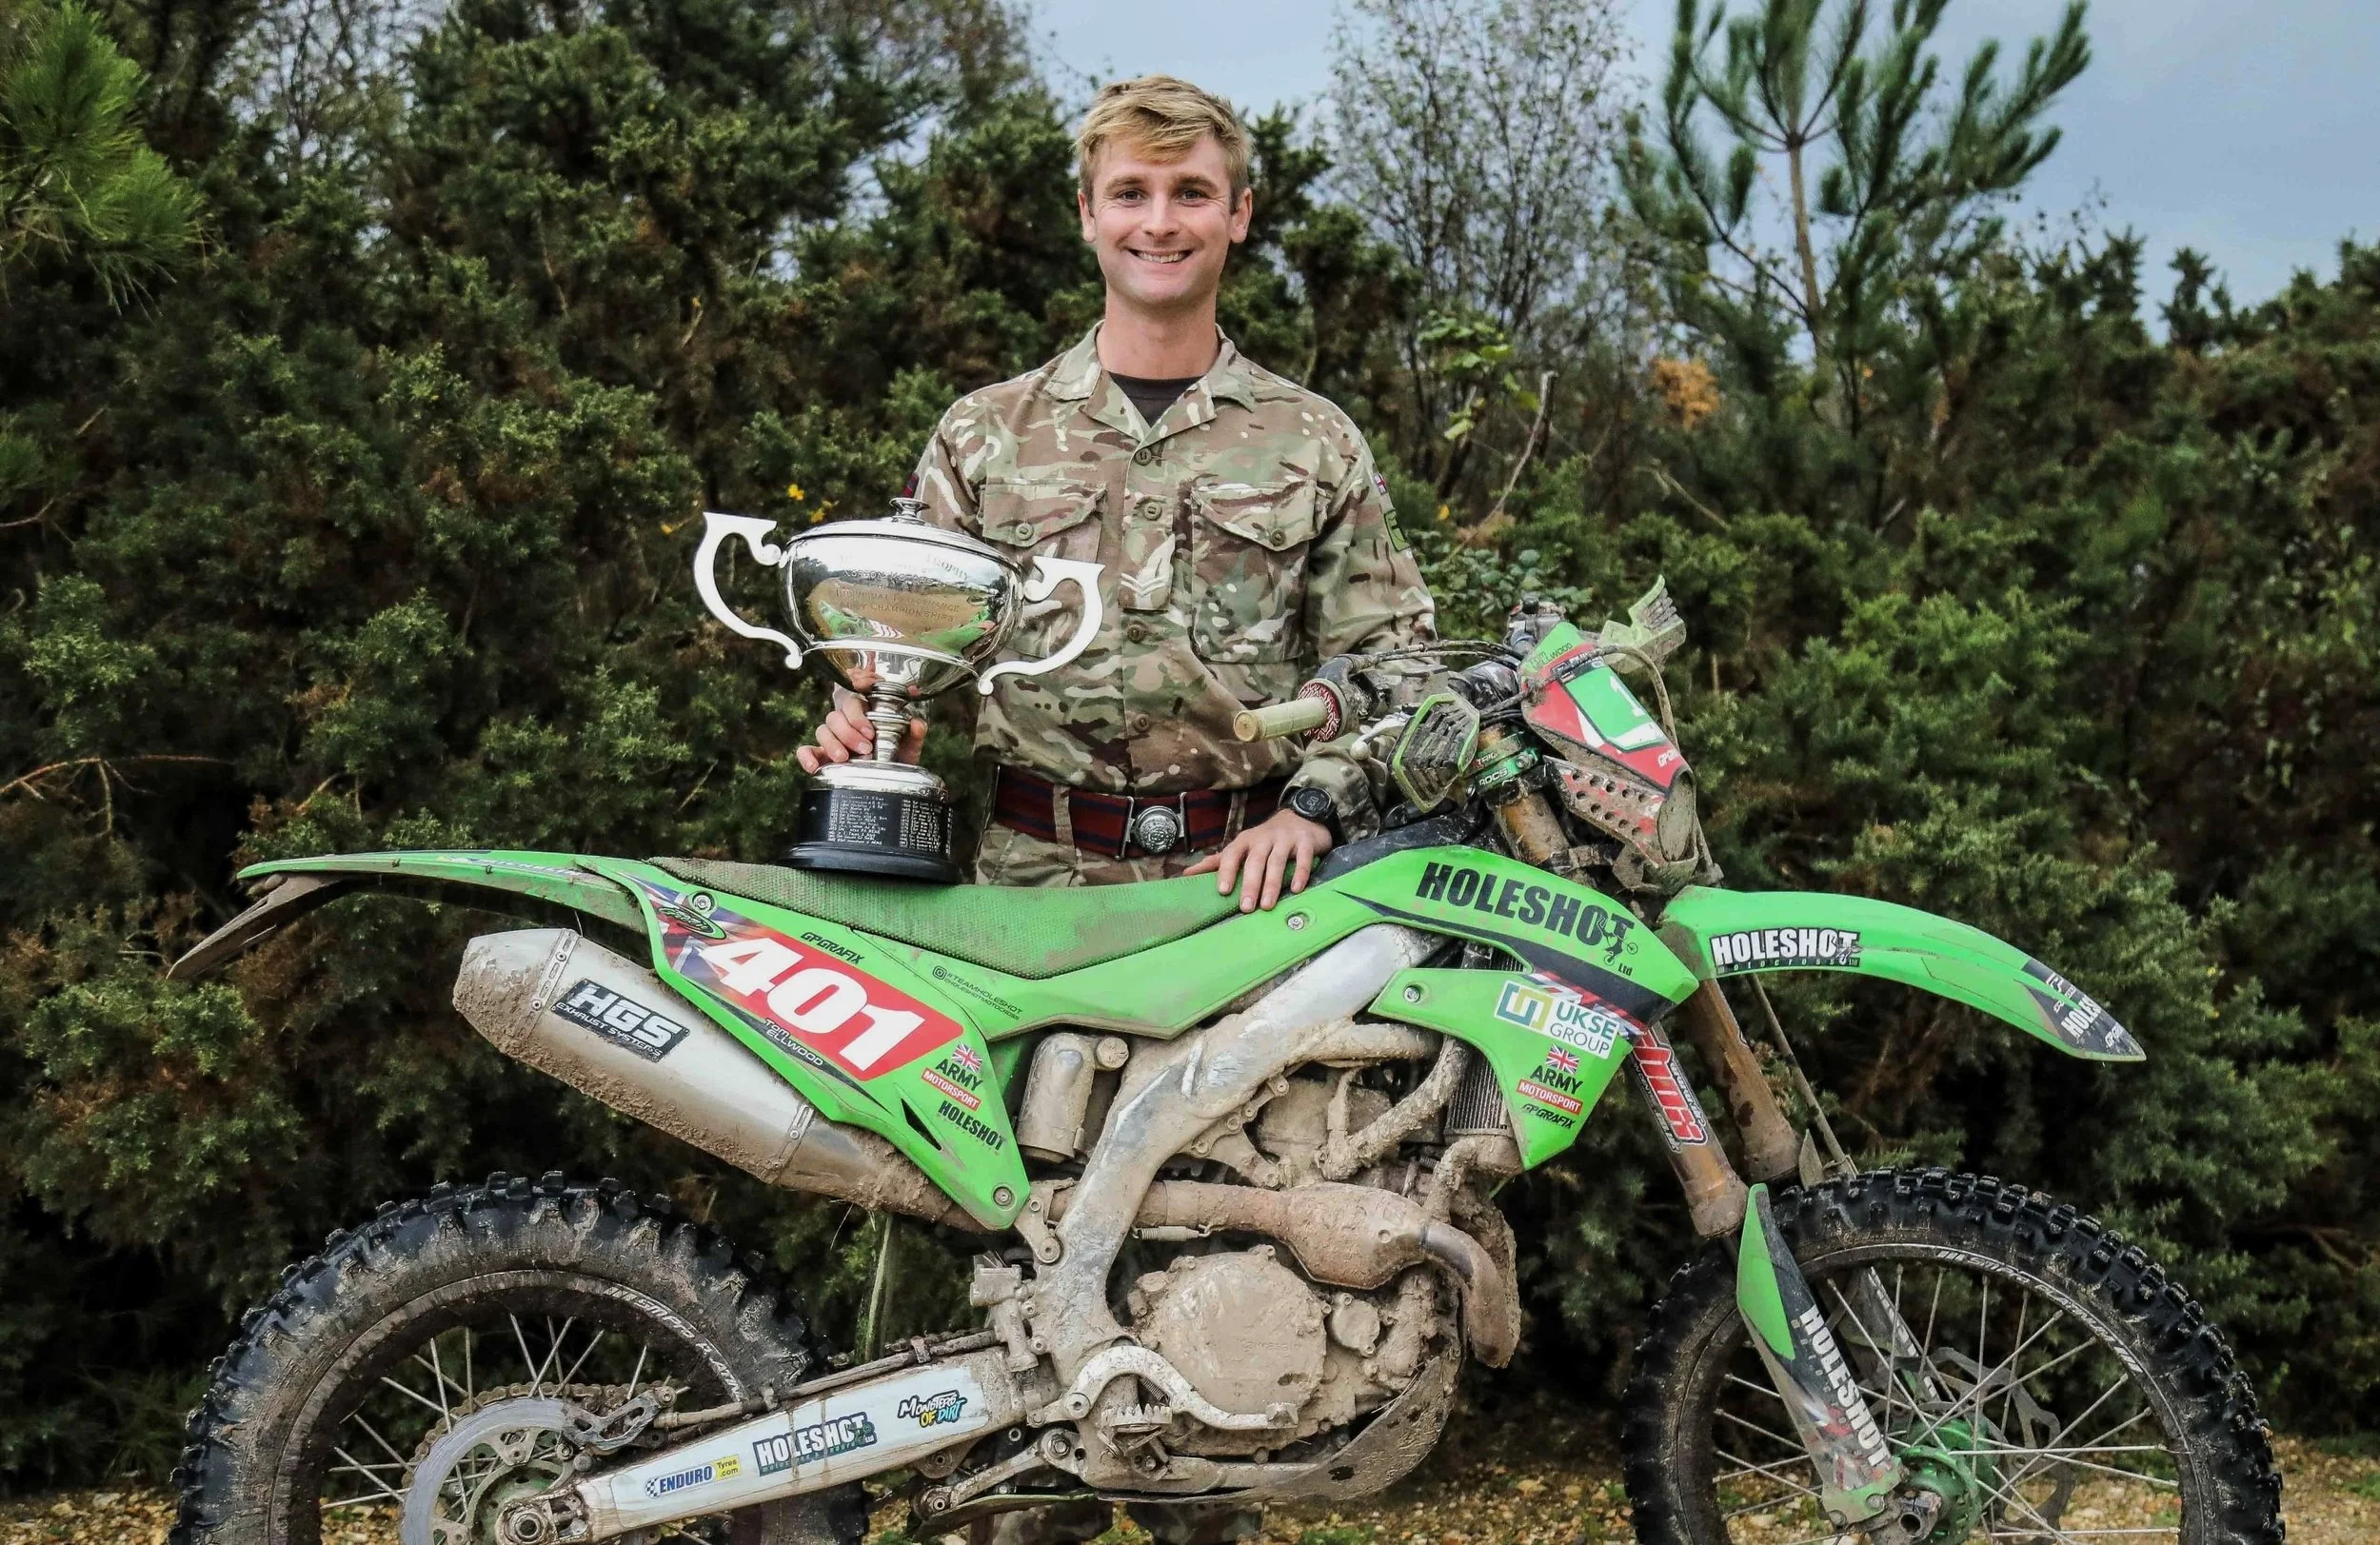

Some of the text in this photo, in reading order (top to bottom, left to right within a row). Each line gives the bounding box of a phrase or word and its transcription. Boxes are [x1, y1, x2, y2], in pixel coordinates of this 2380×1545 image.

[1416, 862, 1636, 953] HOLESHOT
[1712, 928, 1858, 966] HOLESHOT
[1618, 962, 1634, 977] Ltd
[555, 1001, 609, 1029] EXHAUST
[567, 983, 684, 1048] HGS
[698, 937, 925, 1072] 401
[1556, 1001, 1617, 1041] UKSE
[766, 1028, 823, 1066] ELLWOOD
[1550, 1022, 1610, 1055] GROUP
[923, 1070, 980, 1109] MOTORSPORT
[936, 1059, 983, 1092] ARMY
[1530, 1065, 1584, 1095] ARMY
[1518, 1082, 1581, 1113] MOTORSPORT
[938, 1100, 1005, 1151] HOLESHOT
[1799, 1304, 1892, 1467] HOLESHOT
[921, 1398, 966, 1427] OF DIRT
[756, 1415, 865, 1467] HOLESHOT
[660, 1466, 712, 1494] ENDURO
[716, 1458, 737, 1470] Tyres
[721, 1468, 739, 1477] .com
